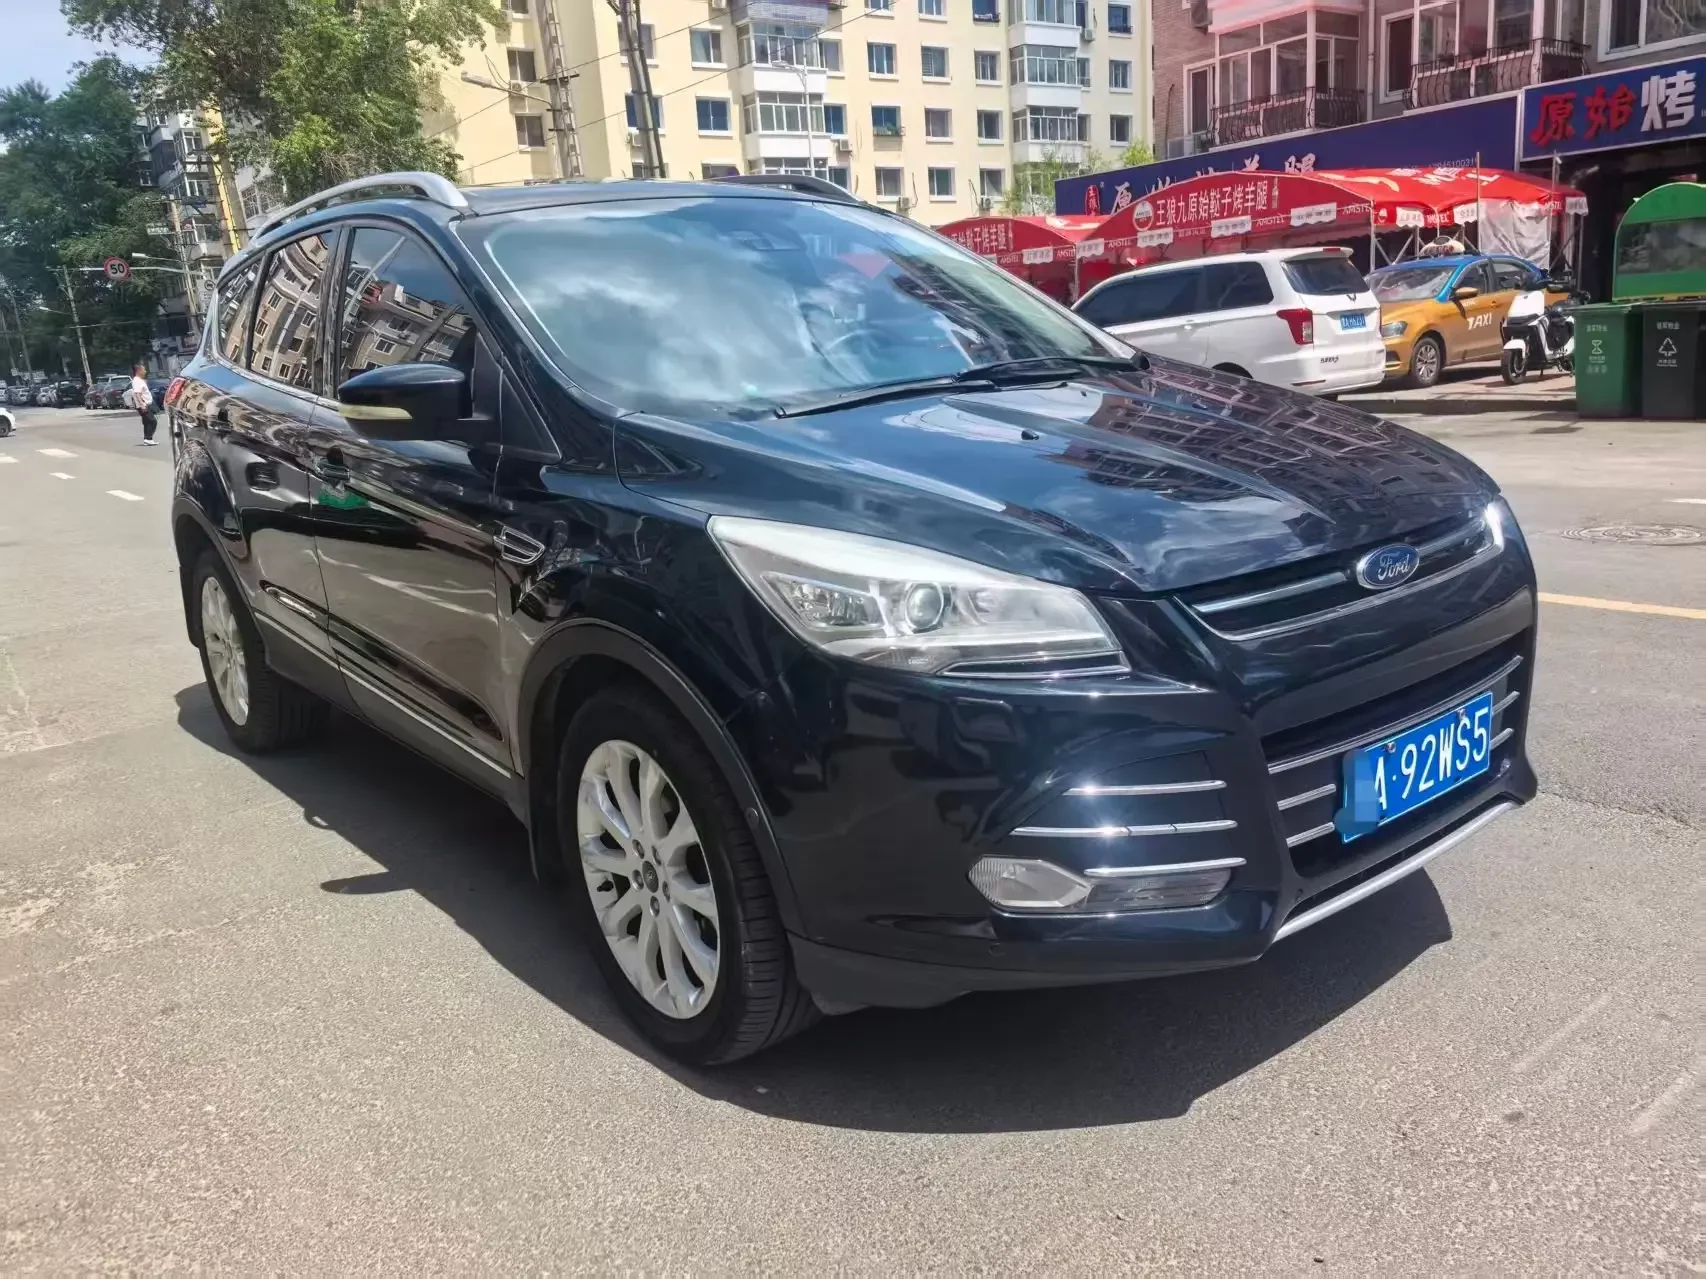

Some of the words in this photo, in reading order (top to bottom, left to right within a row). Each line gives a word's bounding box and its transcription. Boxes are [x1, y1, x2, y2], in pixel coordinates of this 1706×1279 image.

[1530, 70, 1697, 147] 原始烤
[1256, 216, 1285, 227] AMSTEL
[110, 263, 125, 275] 50
[1466, 312, 1492, 330] TAXI
[1377, 551, 1410, 580] Ford
[1374, 706, 1489, 814] A·92WS5
